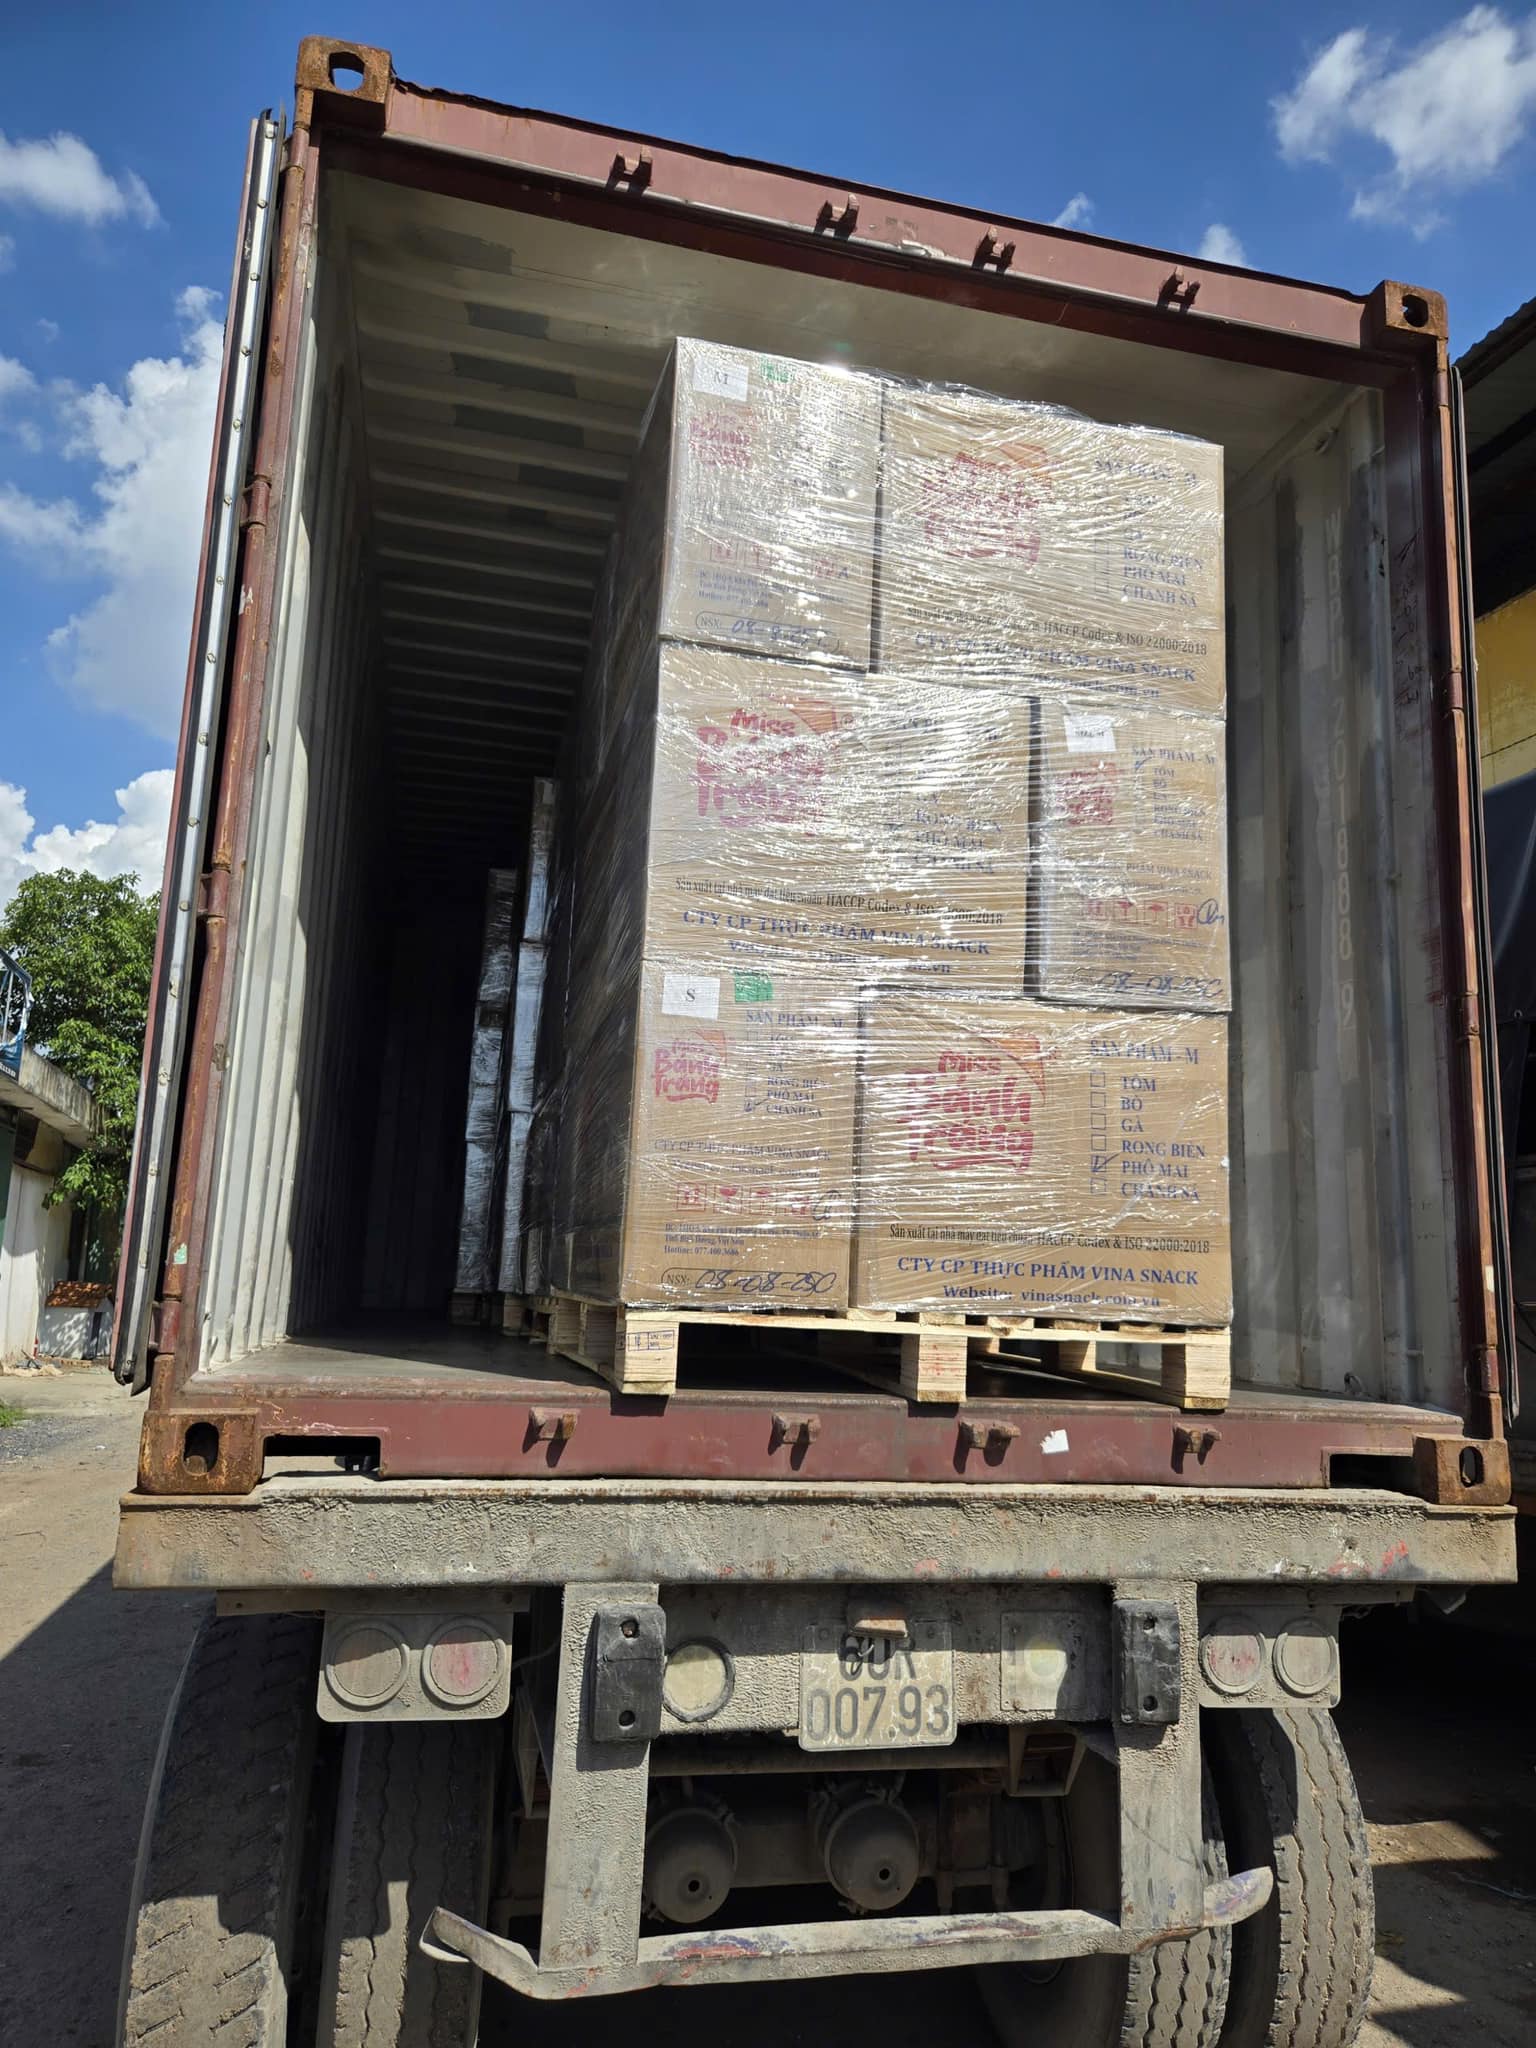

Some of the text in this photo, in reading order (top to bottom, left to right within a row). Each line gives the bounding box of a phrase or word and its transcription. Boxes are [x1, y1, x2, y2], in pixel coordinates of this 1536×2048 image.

[730, 707, 796, 737] Miss
[826, 892, 866, 908] HACCP
[683, 909, 721, 926] CTY
[727, 915, 752, 930] CP
[685, 988, 696, 1002] S
[1186, 1047, 1199, 1065] M
[1121, 1074, 1156, 1092] TÔM
[1122, 1140, 1166, 1156] RONG
[1159, 1163, 1189, 1178] MAI
[1113, 1235, 1122, 1249] &
[1125, 1236, 1143, 1251] ISO
[1145, 1238, 1211, 1254] 22000:2018
[898, 1256, 935, 1273] CTY
[941, 1258, 965, 1274] CP
[970, 1260, 1025, 1280] THỰC
[1091, 1266, 1136, 1282] VINA
[1140, 1268, 1199, 1285] SNACK
